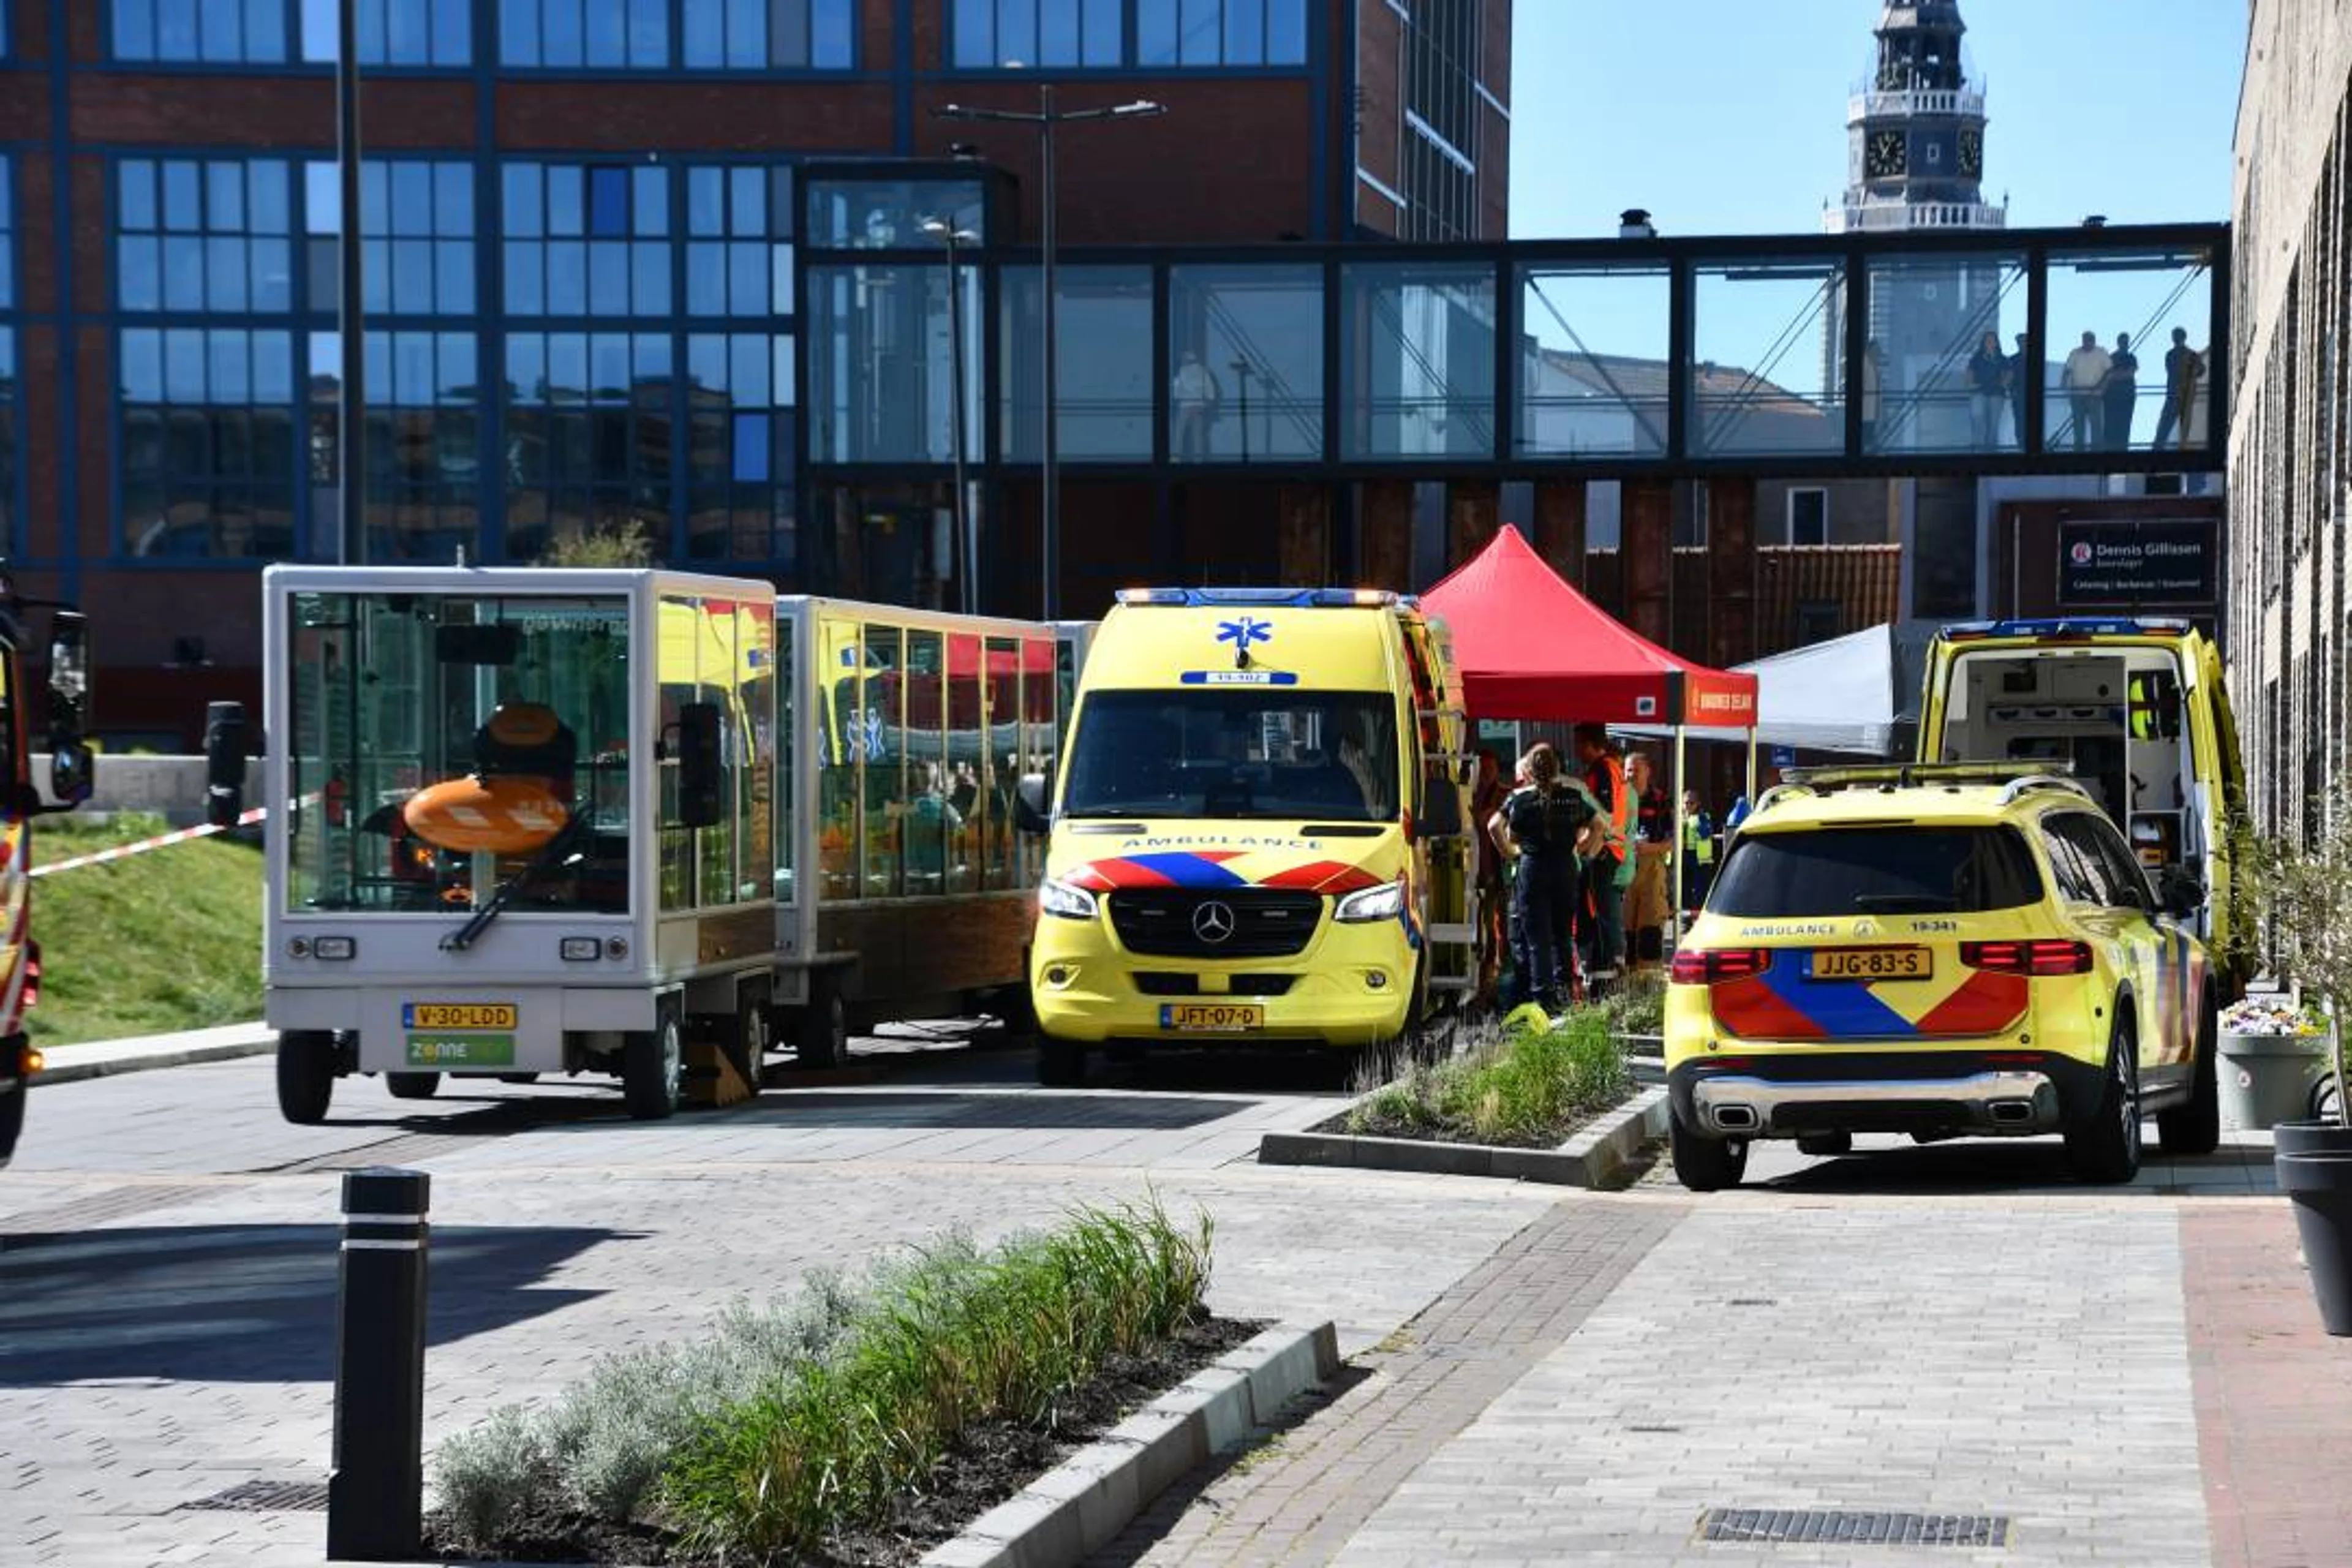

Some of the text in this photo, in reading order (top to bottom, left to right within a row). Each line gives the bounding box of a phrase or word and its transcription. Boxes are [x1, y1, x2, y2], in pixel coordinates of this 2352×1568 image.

[2097, 544, 2142, 556] Dennis
[1123, 835, 1322, 850] AMBULANCE
[1742, 923, 1835, 937] AMBULANCE
[1820, 954, 1918, 974] JJG-83-S
[419, 1008, 508, 1025] V-30-LDD
[1177, 1008, 1253, 1024] JFT-07-D
